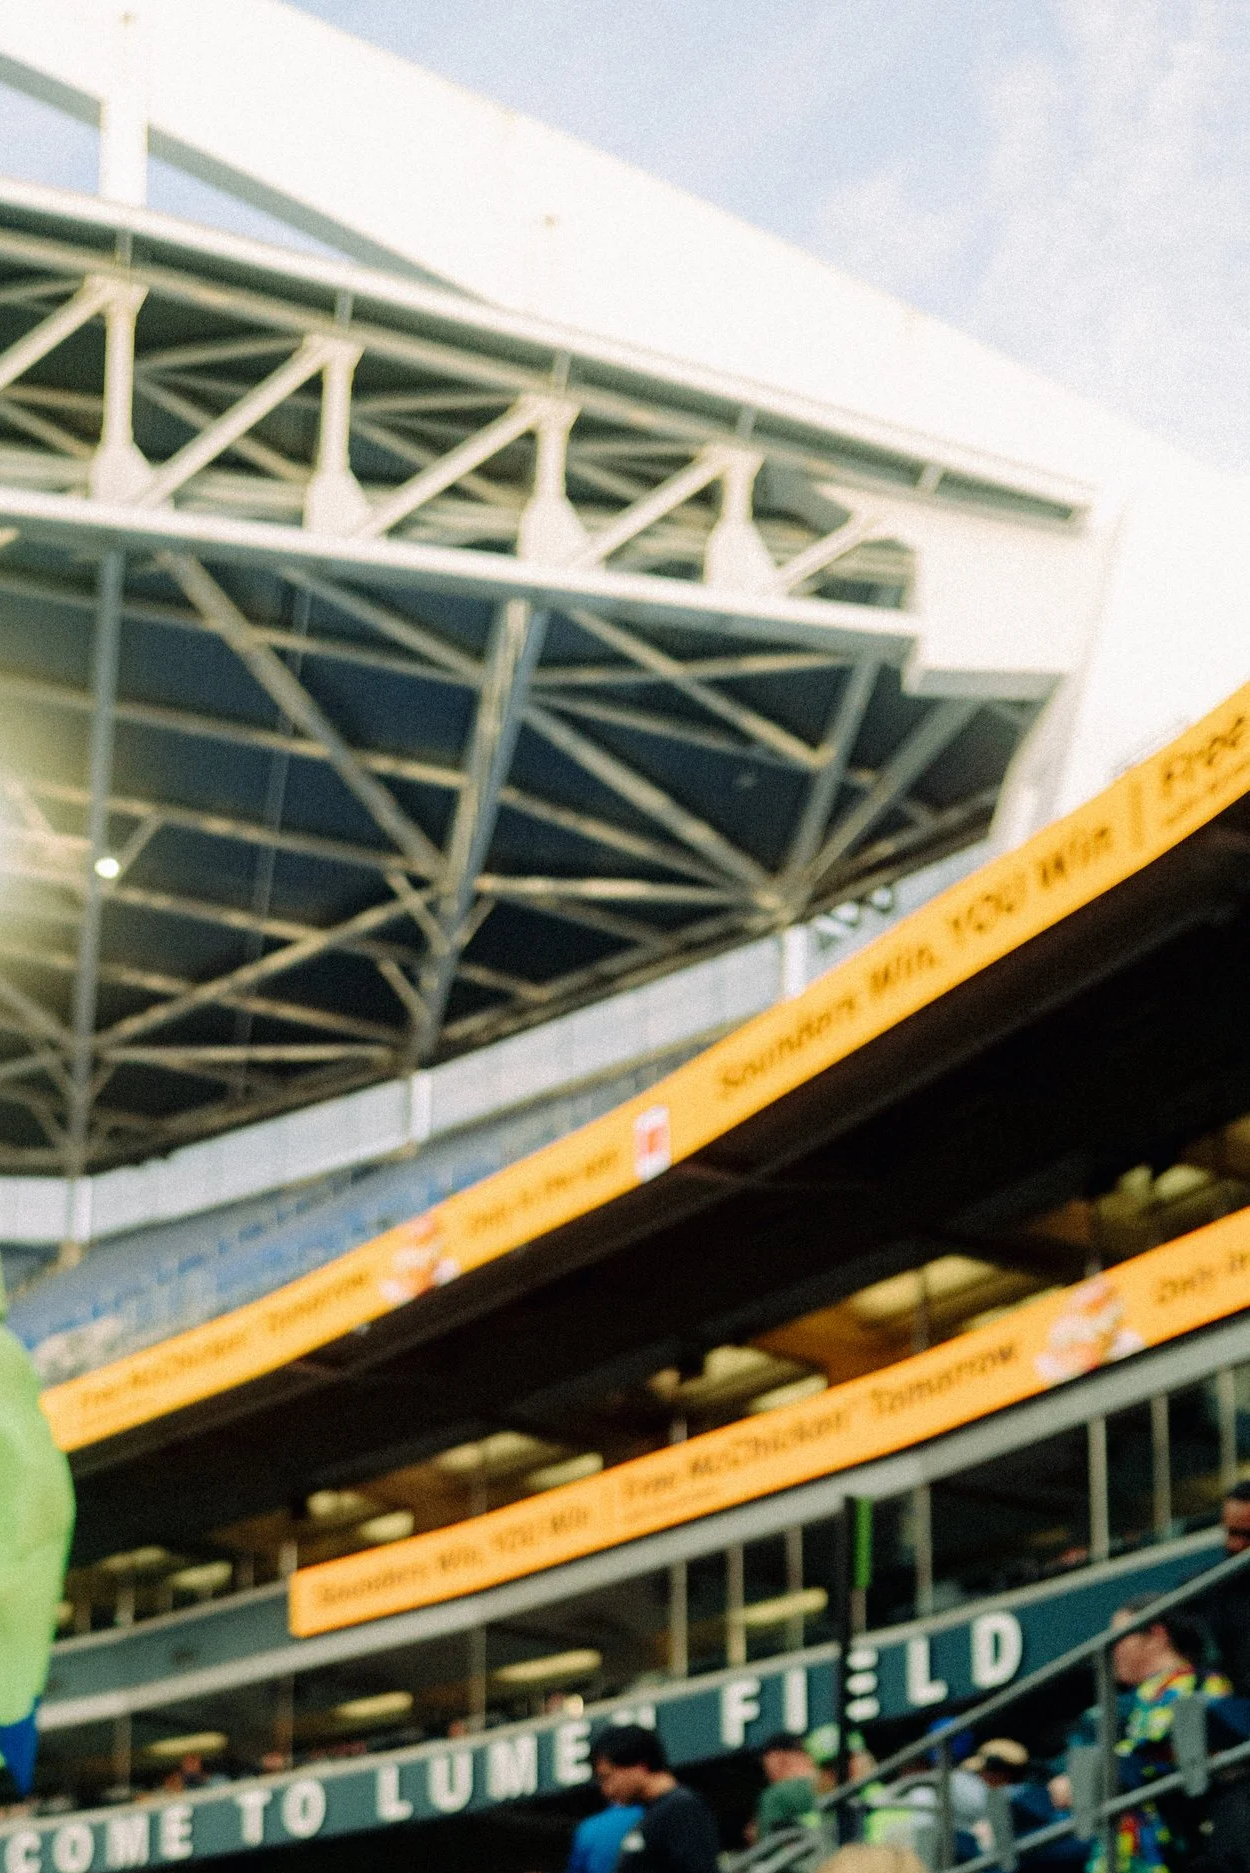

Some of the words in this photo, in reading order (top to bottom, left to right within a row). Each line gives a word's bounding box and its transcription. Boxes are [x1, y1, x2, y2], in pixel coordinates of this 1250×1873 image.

[1035, 826, 1115, 889] Win
[869, 1341, 1019, 1415] Tomorrow
[237, 1778, 327, 1846] TO
[375, 1704, 657, 1823] LUME
[719, 1610, 1024, 1749] FIELD
